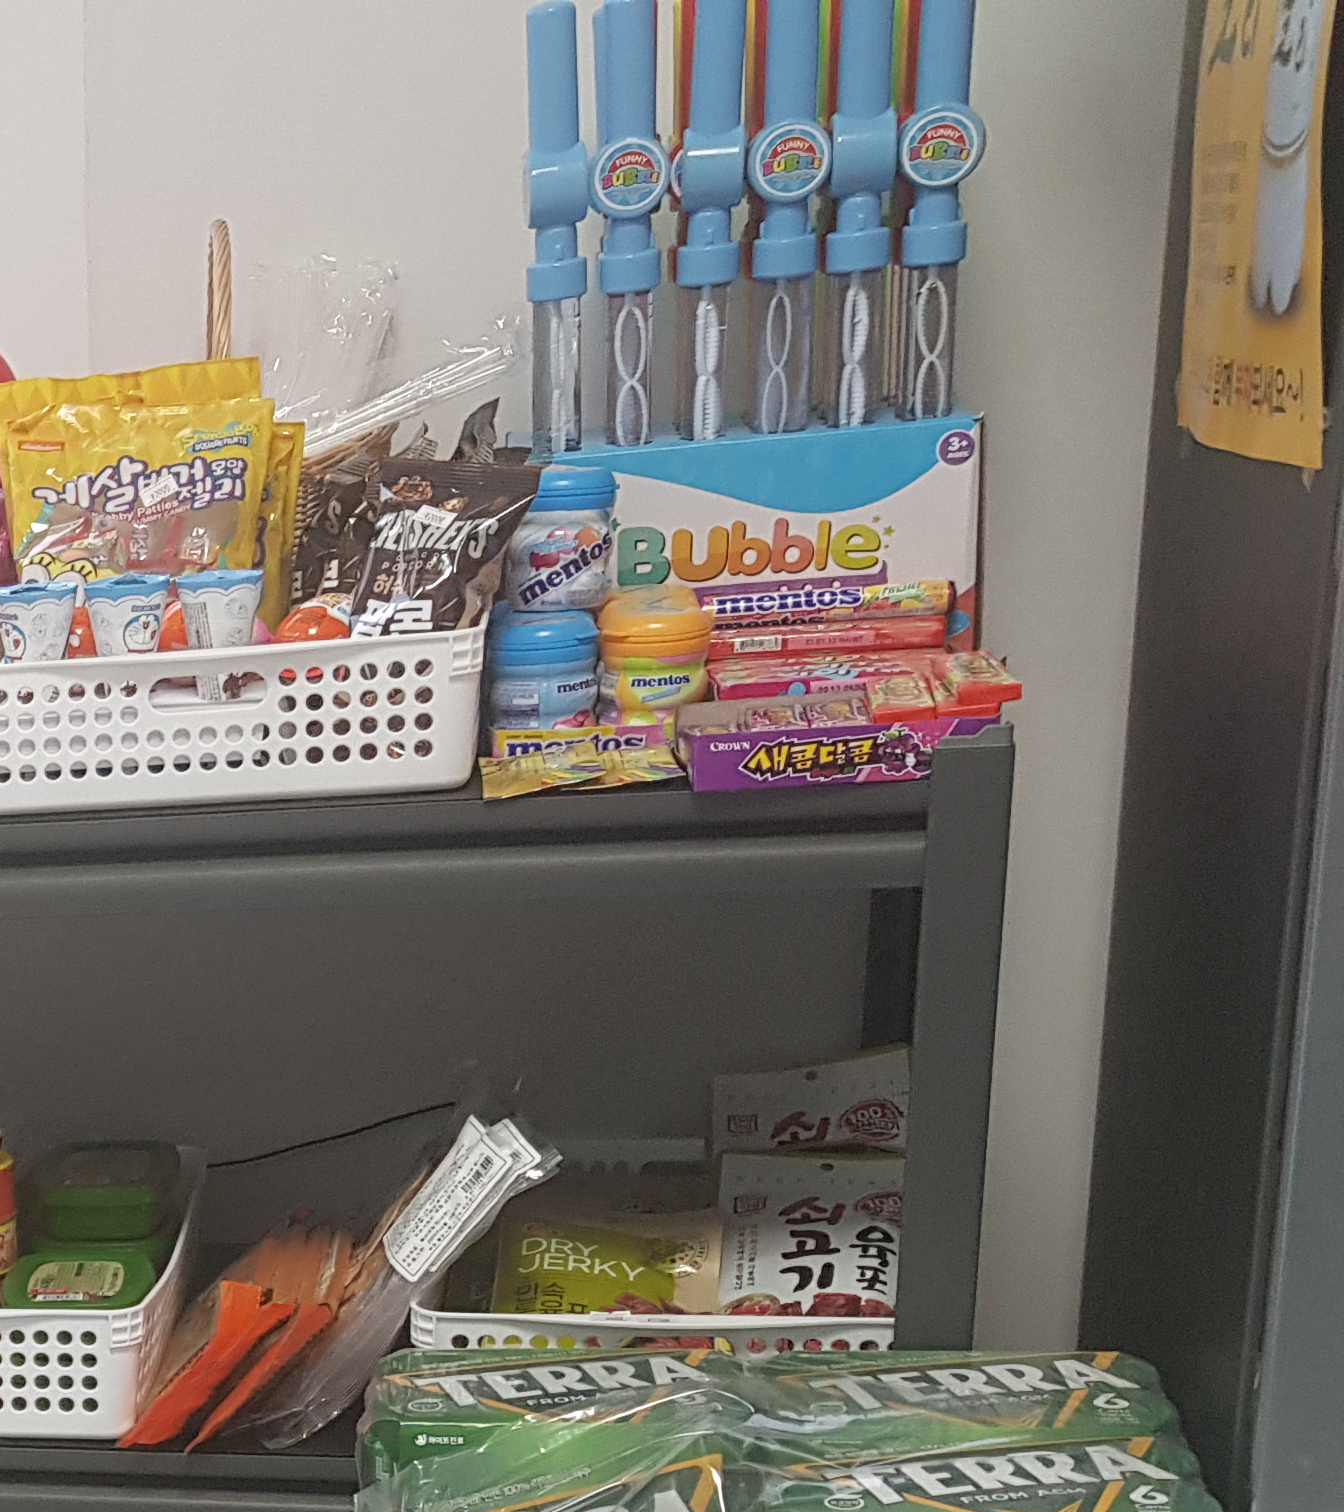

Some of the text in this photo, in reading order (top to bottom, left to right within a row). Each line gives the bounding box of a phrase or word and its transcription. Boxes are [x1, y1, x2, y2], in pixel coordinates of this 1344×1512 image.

[946, 435, 969, 452] 3+
[519, 531, 615, 605] mentos
[714, 586, 863, 616] mentos
[630, 674, 691, 688] mentos
[742, 737, 874, 776] 새콤달콤
[521, 1237, 599, 1258] DRY
[518, 1253, 645, 1281] JERKY
[414, 1356, 711, 1407] TERRA
[809, 1359, 1141, 1411] TERRA
[823, 1444, 1180, 1506] TERRA
[959, 1489, 1028, 1505] FROM
[1129, 1485, 1170, 1505] 6
